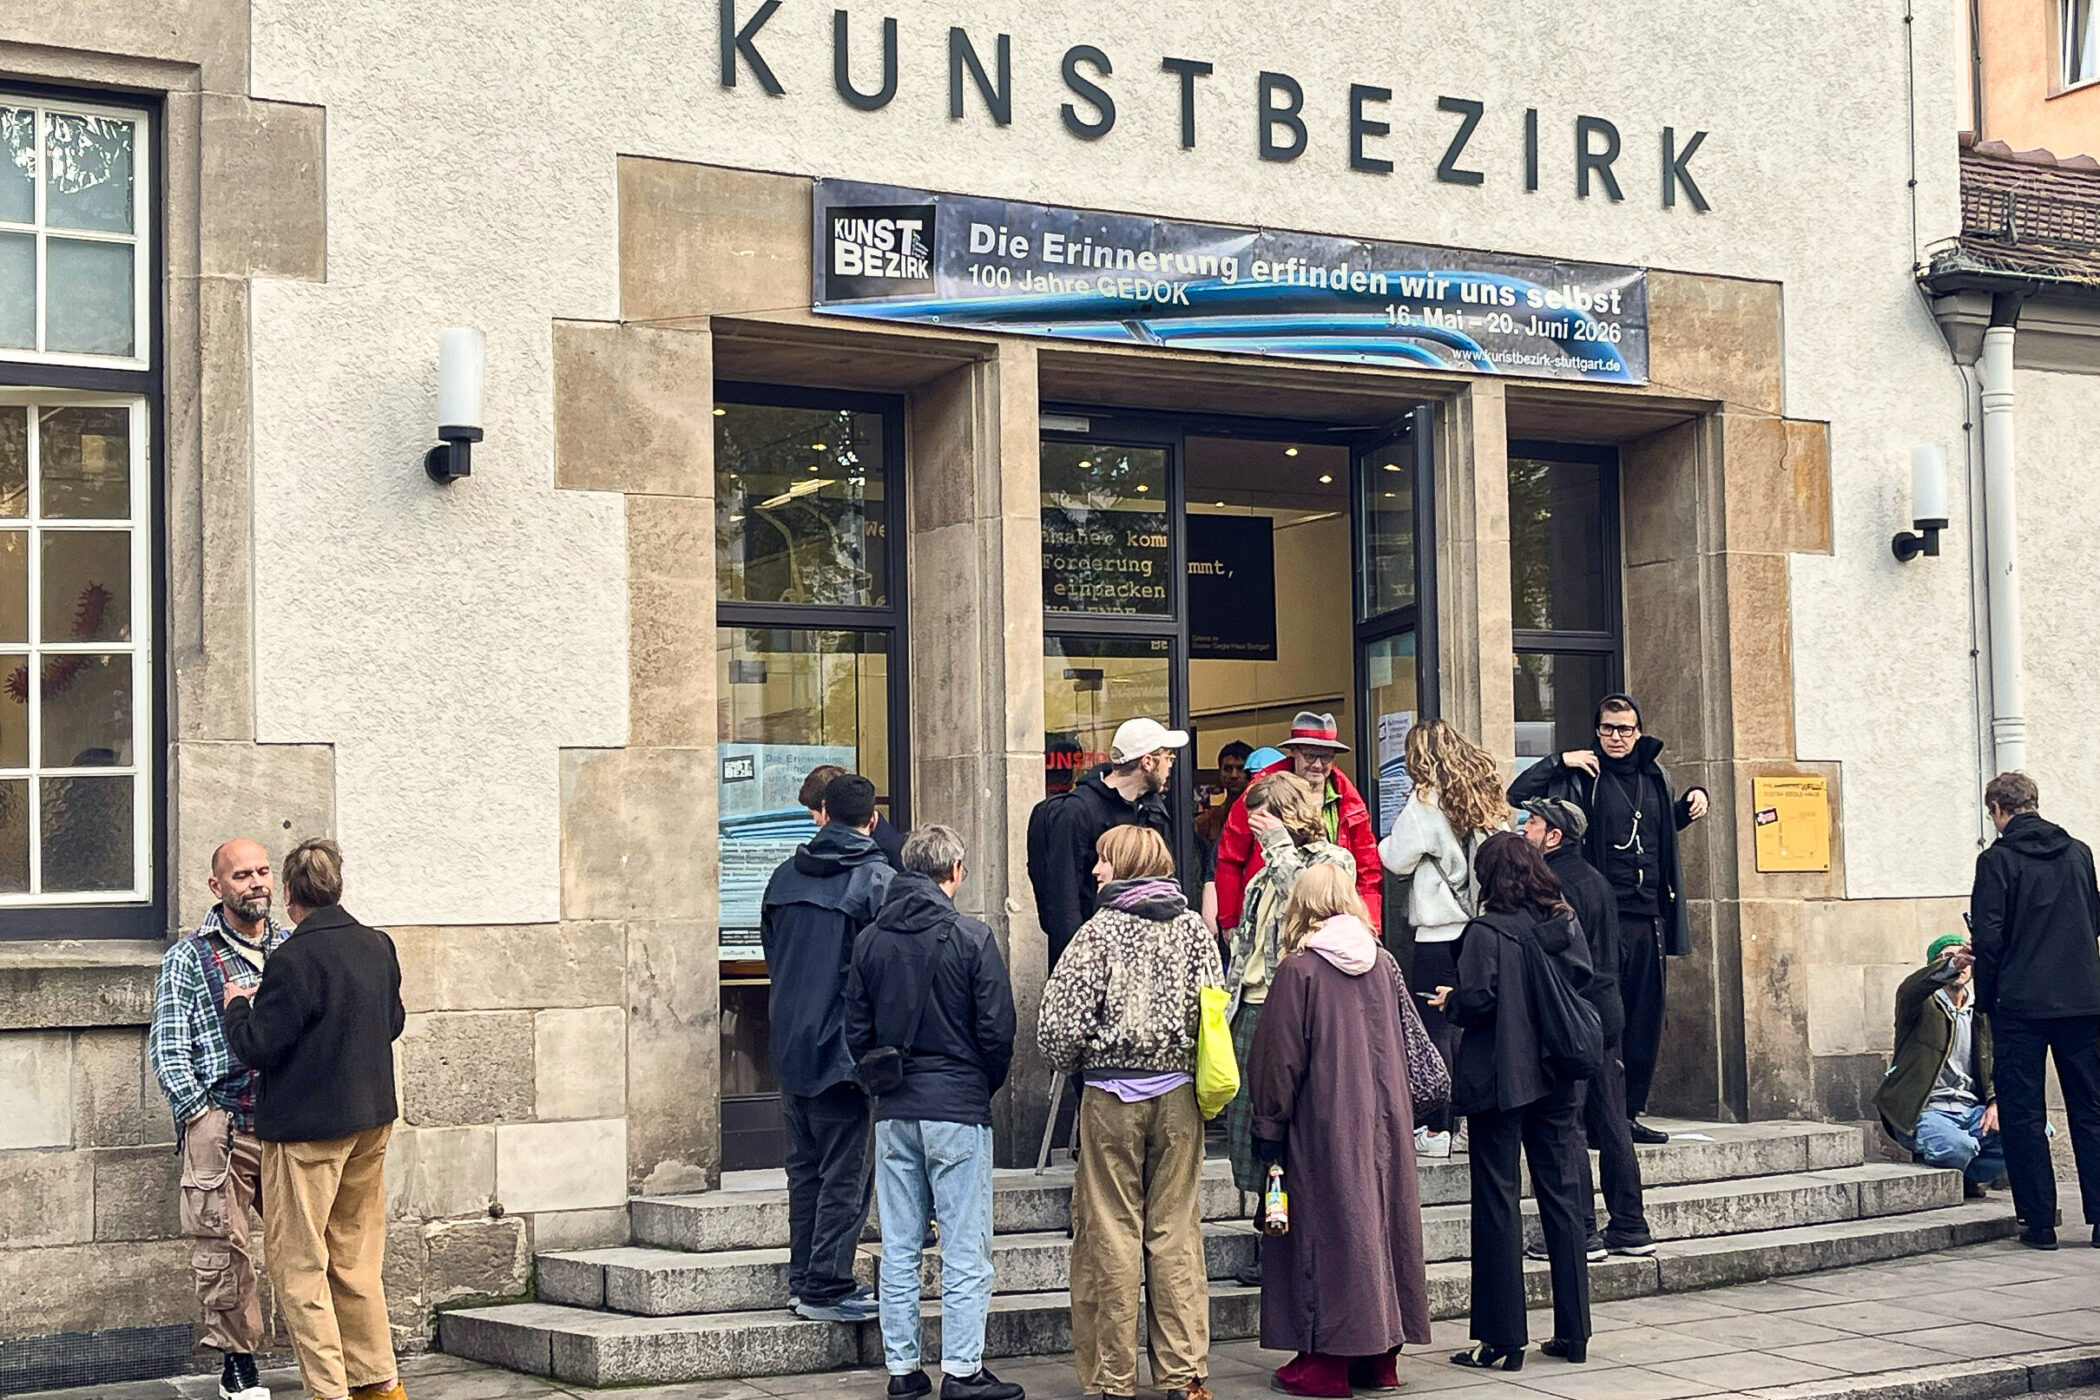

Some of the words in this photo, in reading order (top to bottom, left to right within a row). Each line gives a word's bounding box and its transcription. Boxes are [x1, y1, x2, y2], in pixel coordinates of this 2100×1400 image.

[719, 0, 1712, 212] KUNSTBEZIRK
[834, 218, 923, 256] KUNST
[834, 238, 930, 280] BEZIRK
[969, 222, 1030, 259] Die
[1042, 231, 1239, 284] Erinnerung
[1251, 257, 1387, 295] erfinden
[1400, 271, 1450, 300] wir
[1460, 281, 1516, 306] uns
[1526, 284, 1622, 315] selbst
[968, 263, 1012, 289] 100
[1018, 269, 1090, 296] Jahre
[1096, 275, 1190, 306] GEDOK
[1385, 303, 1417, 327] 16.
[1423, 306, 1463, 330] Mai
[1486, 313, 1519, 335] 20.
[1525, 315, 1569, 340] Juni
[1573, 319, 1622, 344] 2026
[1451, 348, 1622, 372] www.kunstbezirk-stuttgart.de
